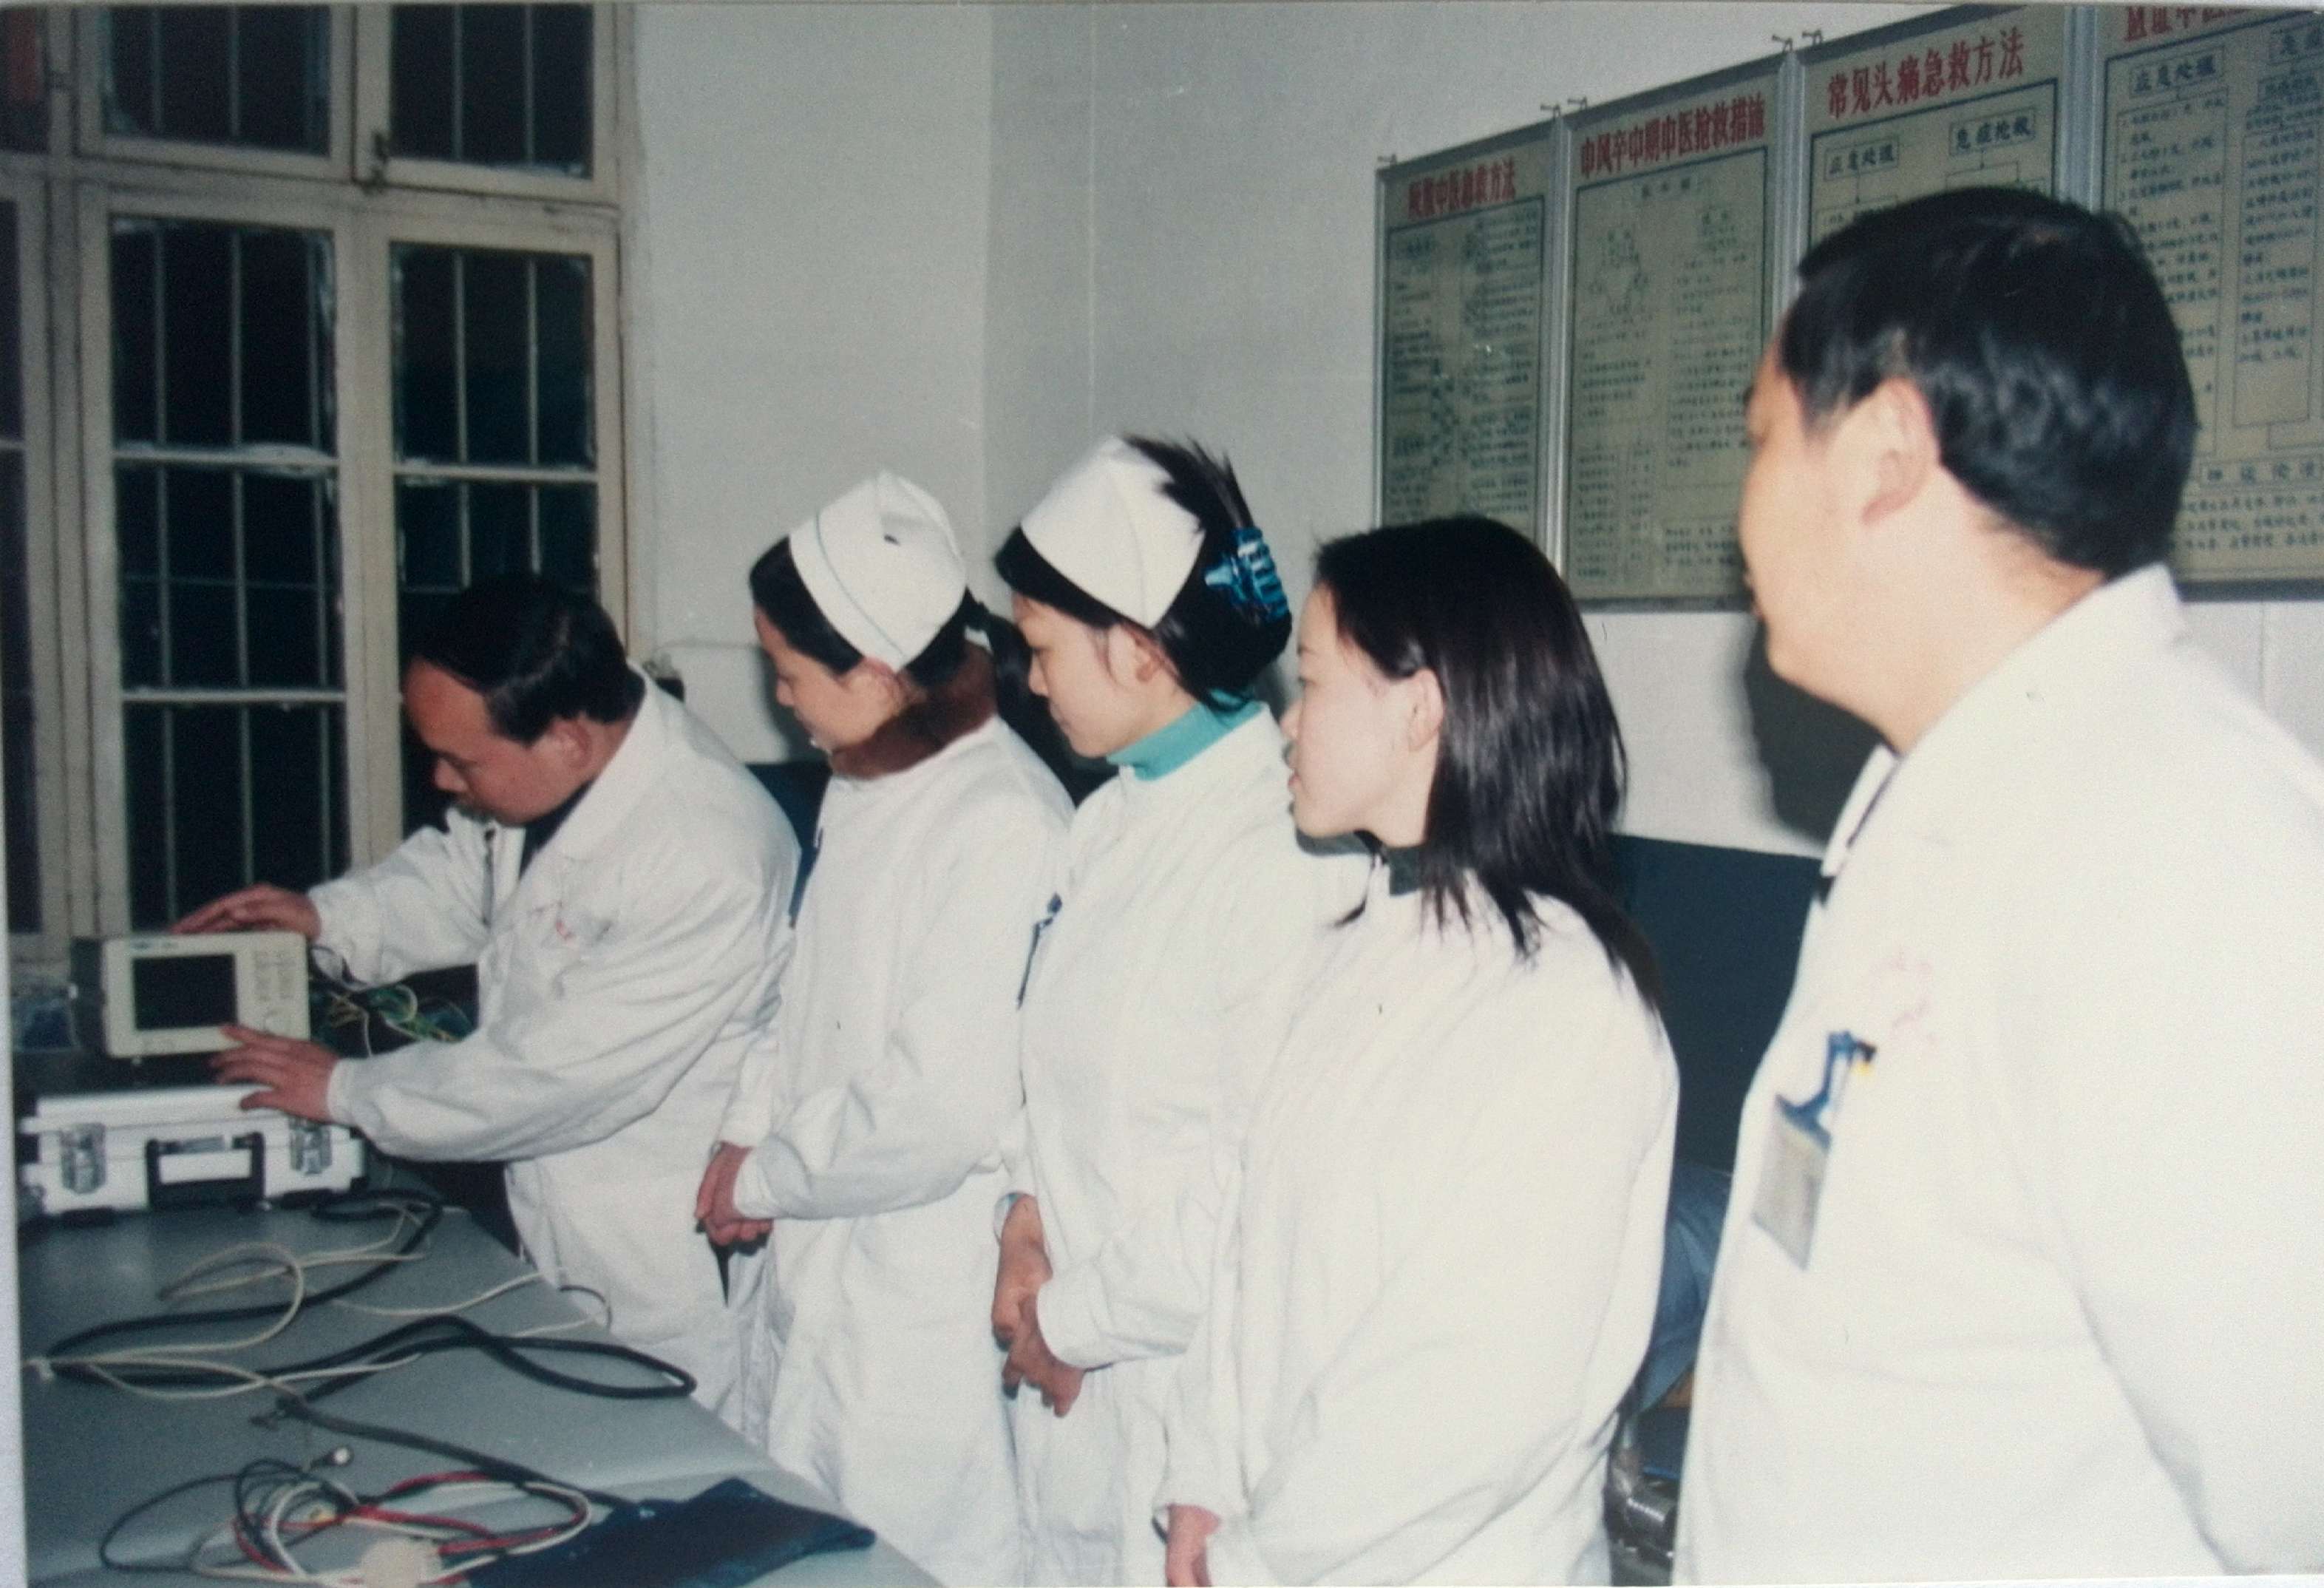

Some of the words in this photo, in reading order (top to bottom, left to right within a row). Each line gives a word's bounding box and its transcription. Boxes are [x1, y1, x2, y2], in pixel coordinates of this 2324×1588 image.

[1828, 26, 2024, 120] 常见头痛急救方法
